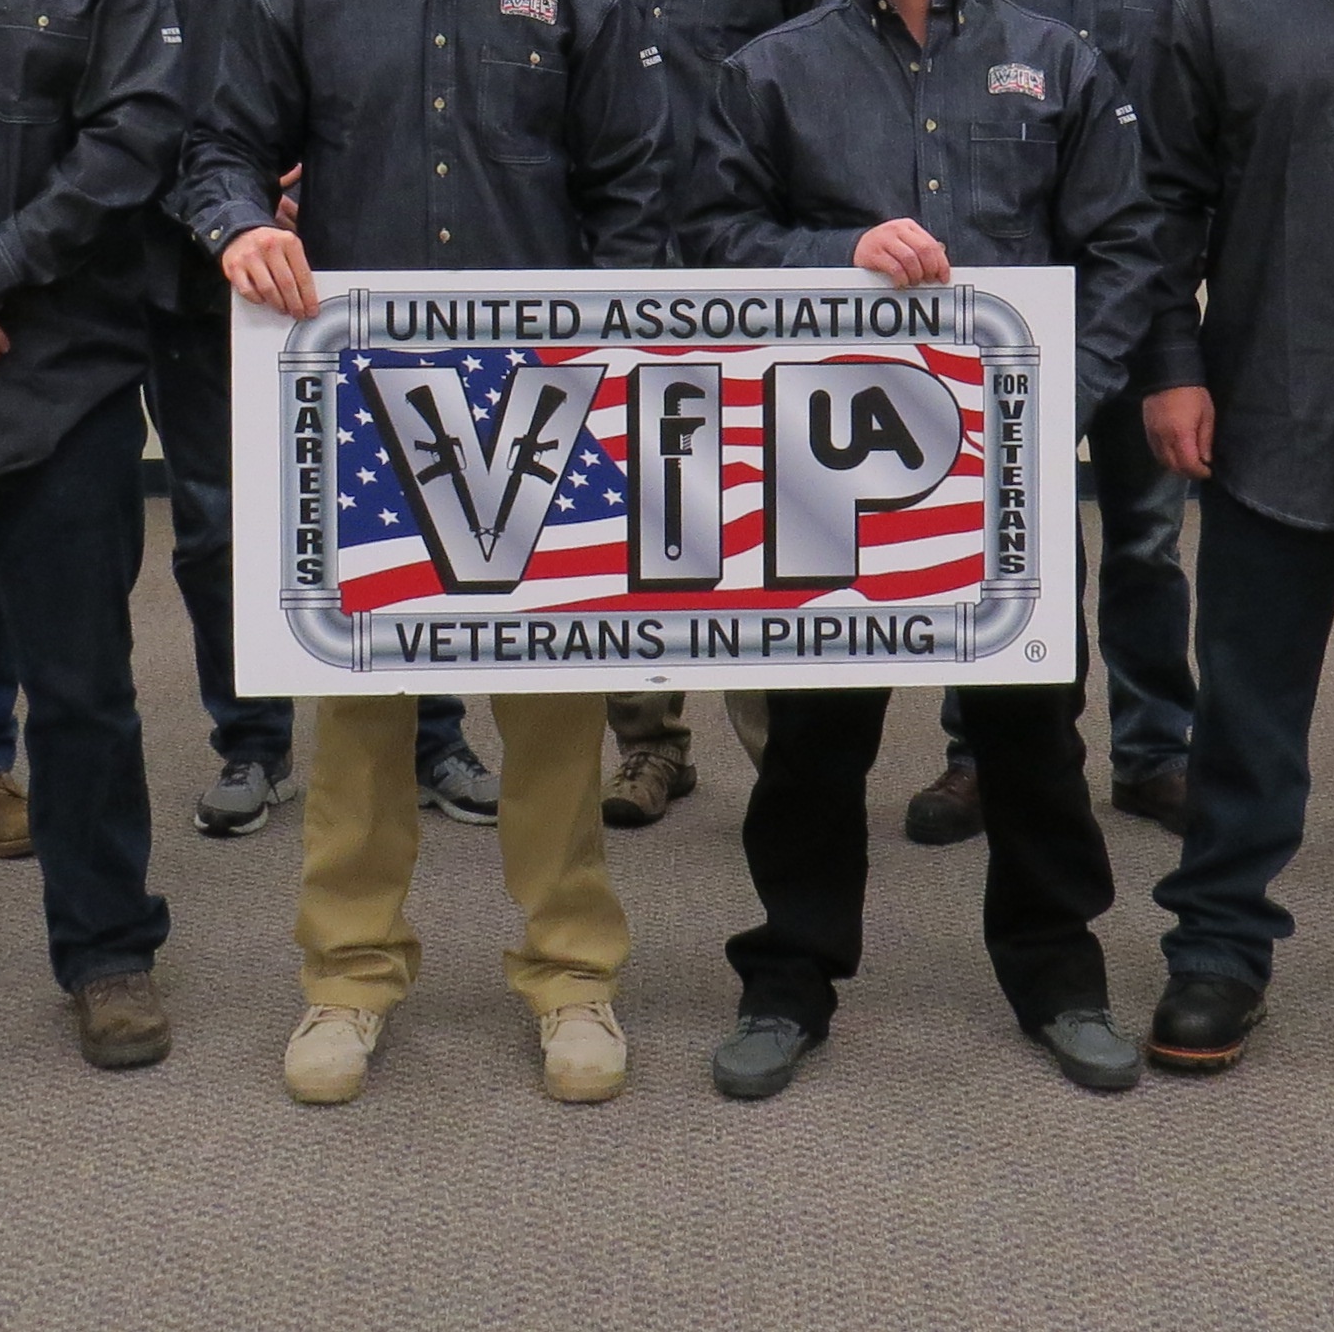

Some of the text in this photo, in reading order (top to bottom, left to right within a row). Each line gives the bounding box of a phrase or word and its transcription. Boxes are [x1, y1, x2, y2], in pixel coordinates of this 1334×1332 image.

[385, 297, 941, 342] UNITED ASSOCIATION
[993, 373, 1029, 395] FOR
[810, 386, 926, 472] UA
[294, 375, 325, 586] CAREERS
[359, 362, 965, 594] VIP
[998, 399, 1027, 575] VETERANS
[395, 615, 936, 663] VETERANS IN PIPING
